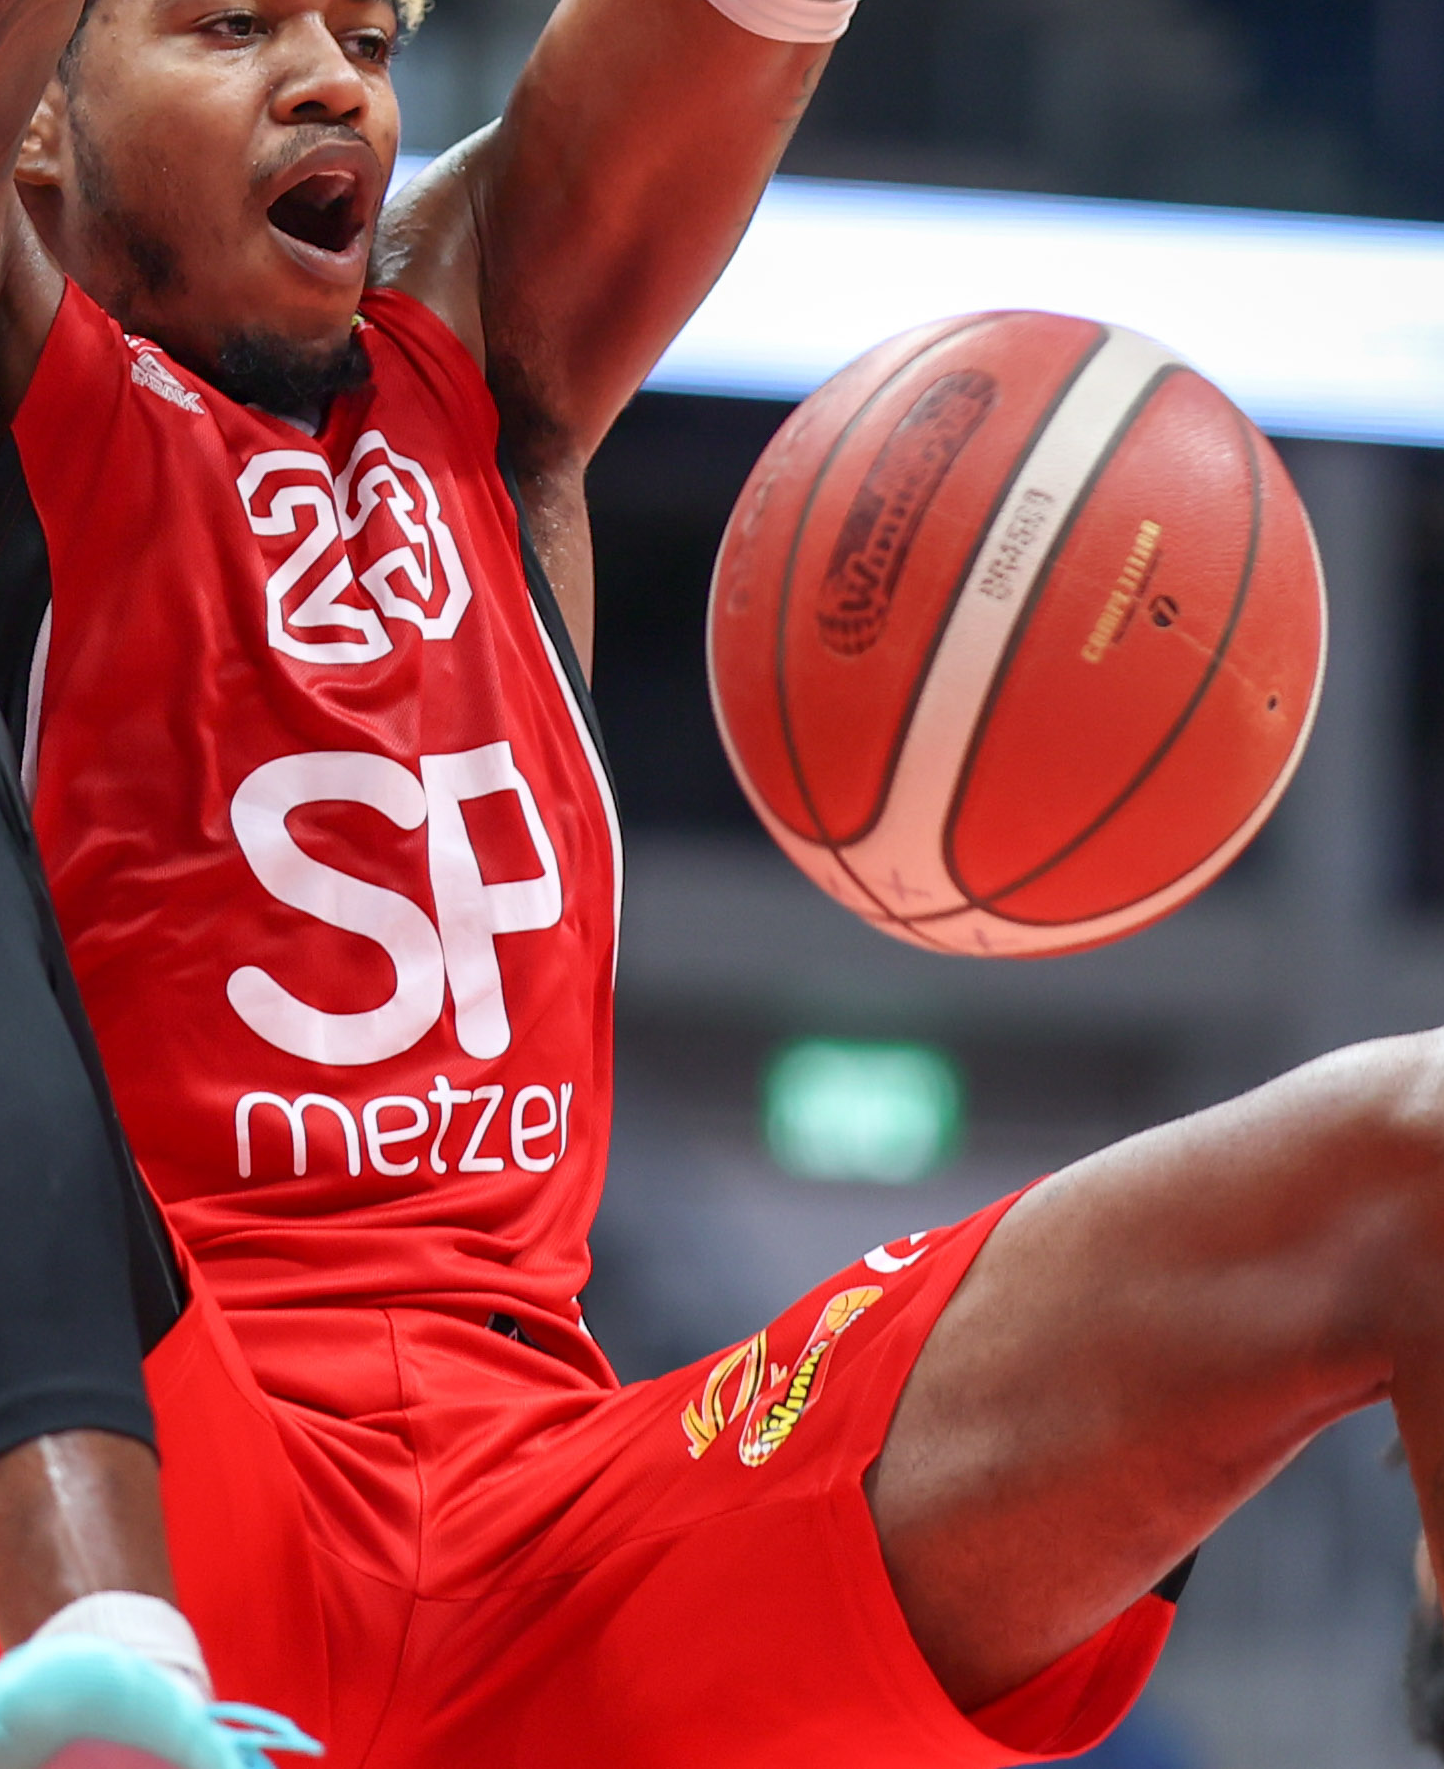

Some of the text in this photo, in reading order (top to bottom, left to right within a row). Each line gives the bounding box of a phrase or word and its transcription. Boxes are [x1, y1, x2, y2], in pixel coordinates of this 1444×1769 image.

[236, 429, 473, 664] 23
[226, 740, 562, 1066] SP
[235, 1075, 573, 1179] metzer
